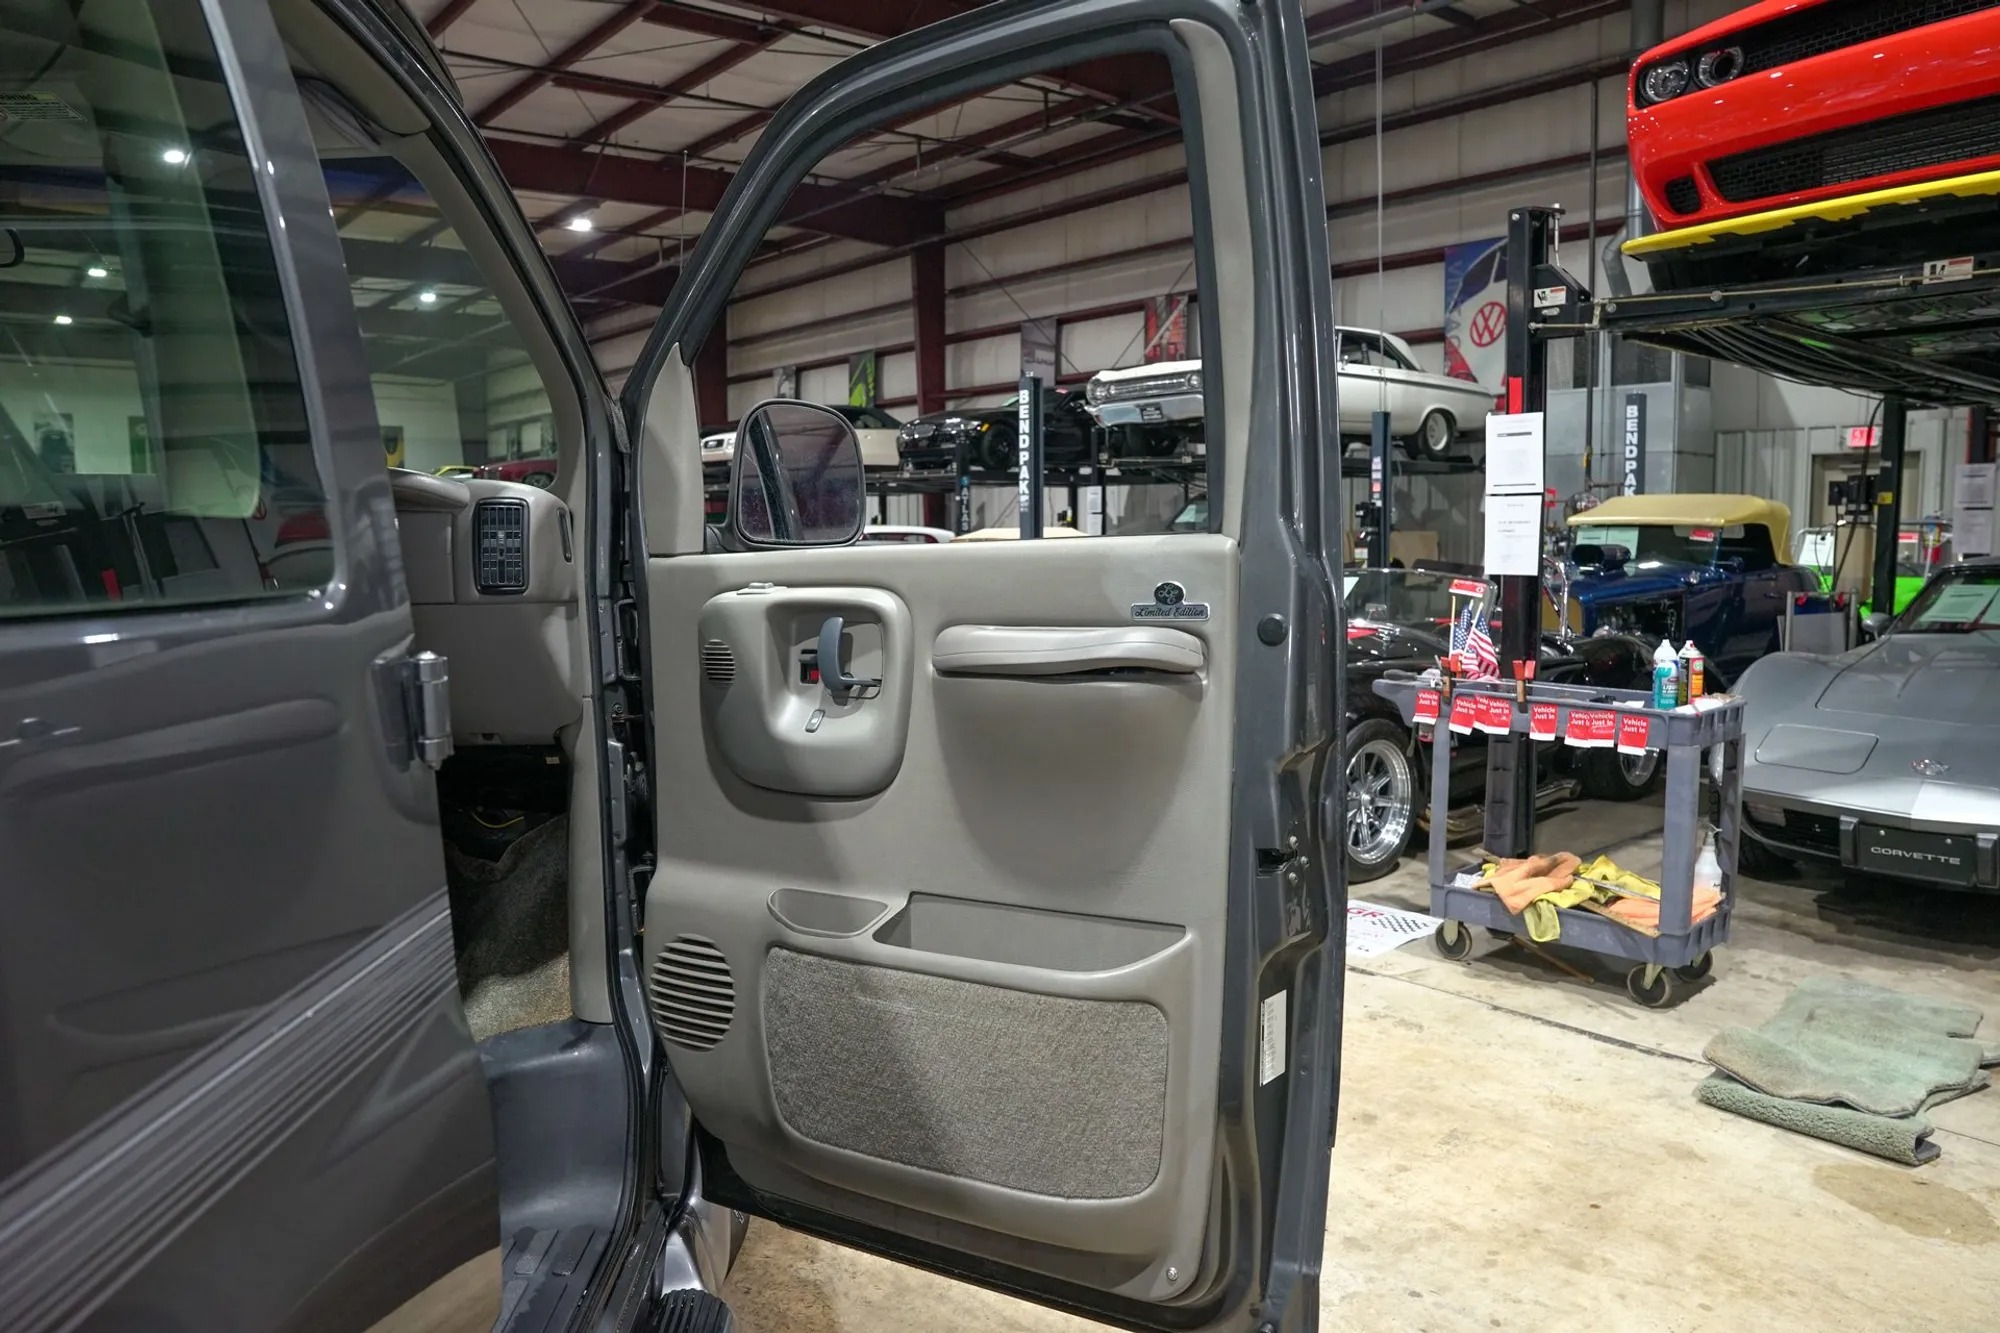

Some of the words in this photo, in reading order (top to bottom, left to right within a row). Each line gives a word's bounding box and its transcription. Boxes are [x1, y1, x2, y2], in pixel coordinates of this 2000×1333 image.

[1018, 389, 1030, 494] BENDPAK
[1624, 405, 1639, 497] BENDPAK
[1135, 607, 1171, 617] Limited
[1173, 607, 1205, 618] Edition
[1623, 718, 1647, 726] Vehicle
[1871, 846, 1960, 865] CORVETTE
